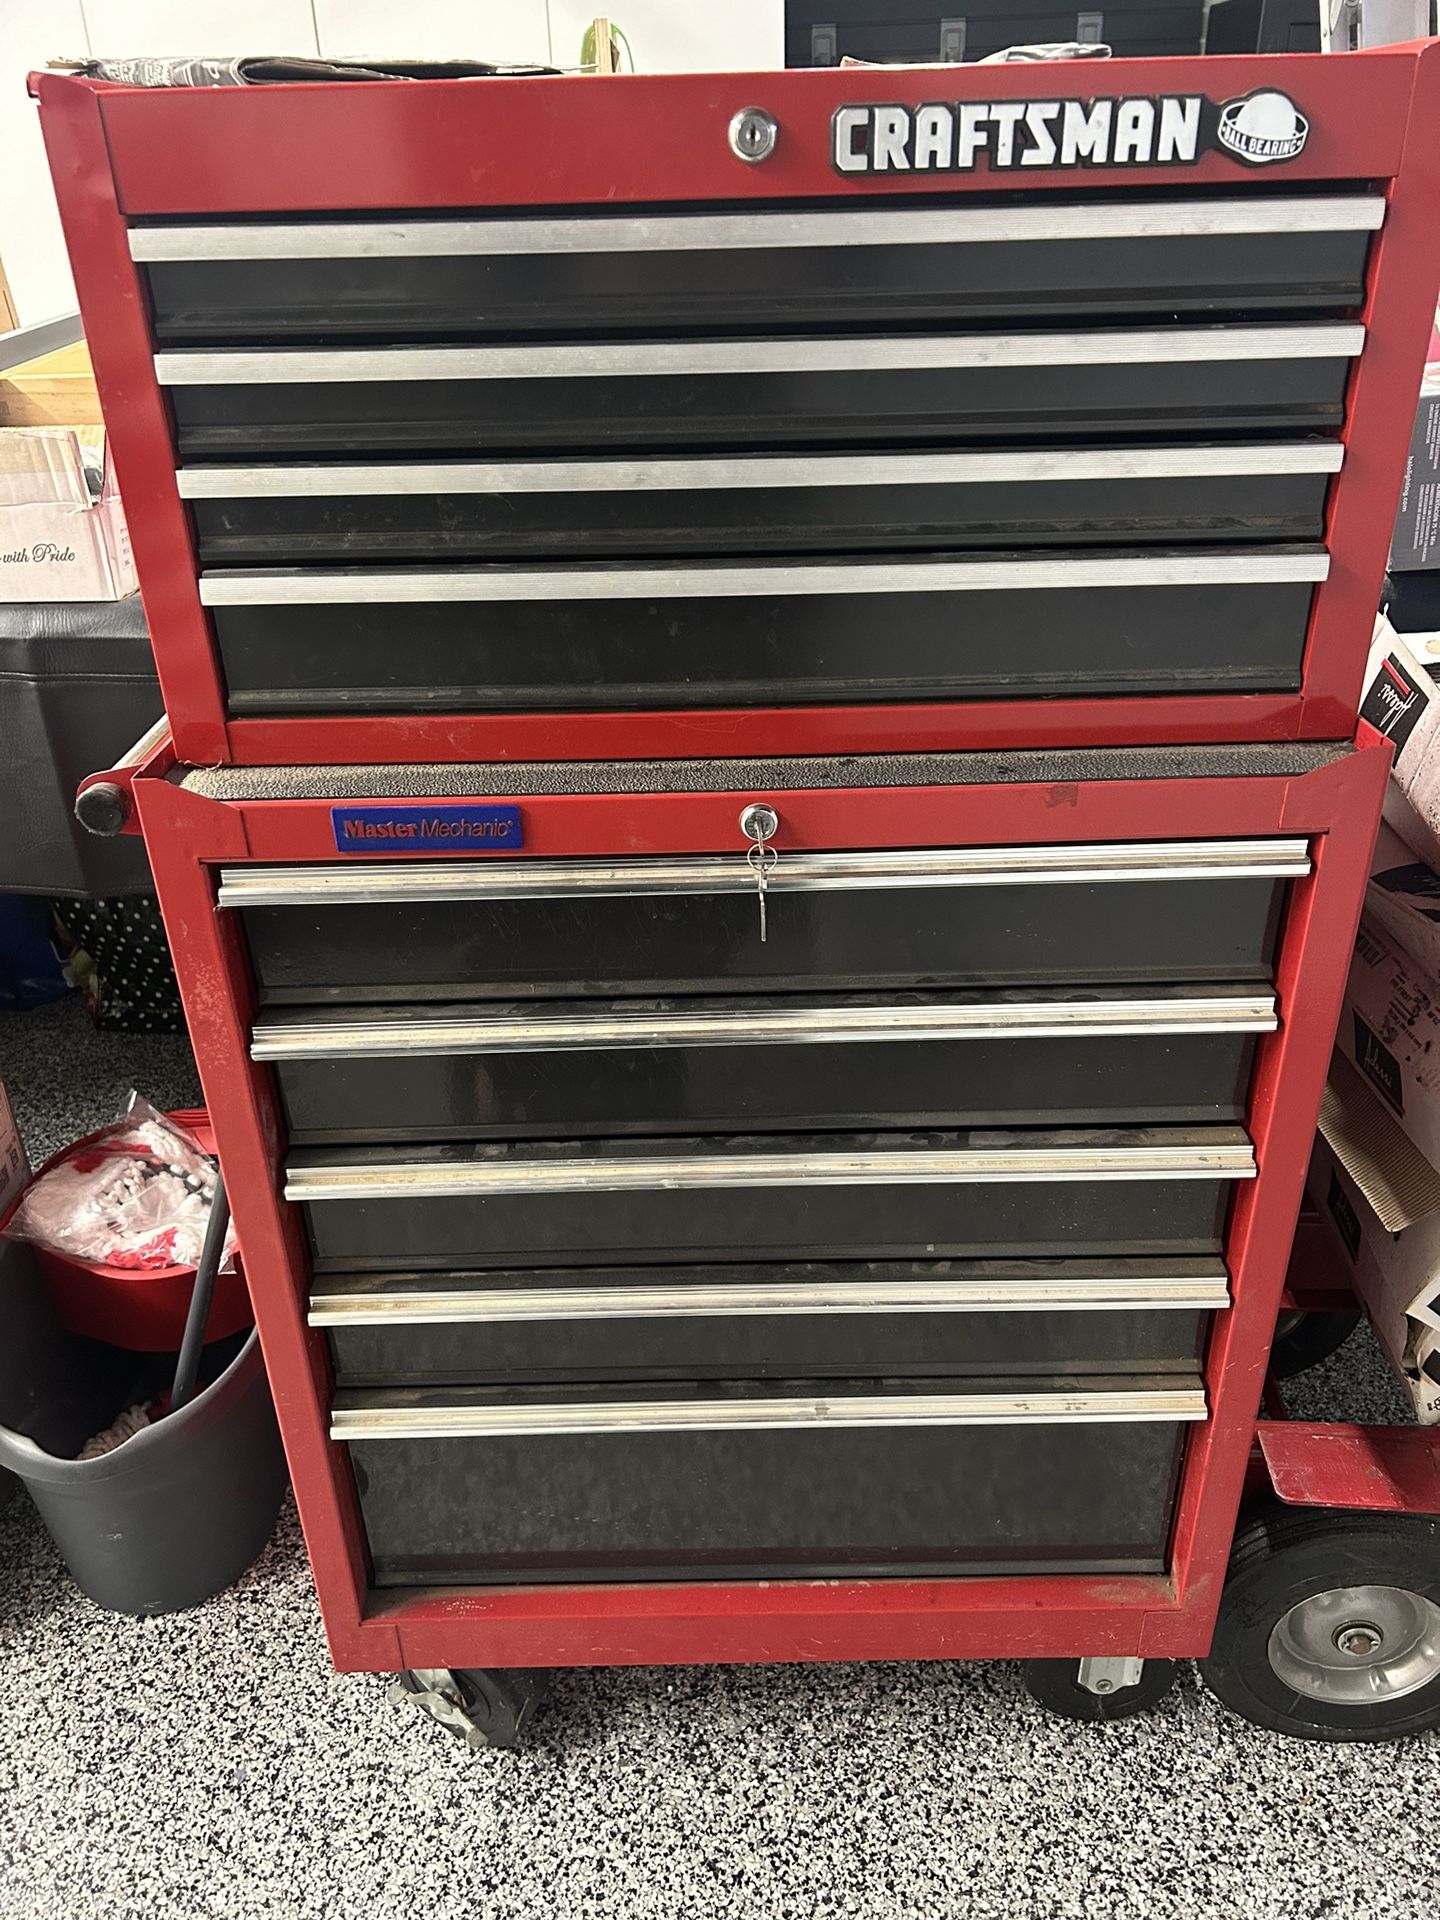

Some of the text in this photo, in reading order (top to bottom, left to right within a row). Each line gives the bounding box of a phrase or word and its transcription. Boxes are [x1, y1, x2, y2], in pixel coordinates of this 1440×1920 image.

[835, 98, 1201, 172] CRAFTSMAN
[1224, 124, 1297, 156] BALL BEARING
[1402, 455, 1414, 513] halolighting.com
[3, 543, 76, 563] with Pride
[1378, 684, 1419, 737] Adessi
[343, 819, 418, 839] Master
